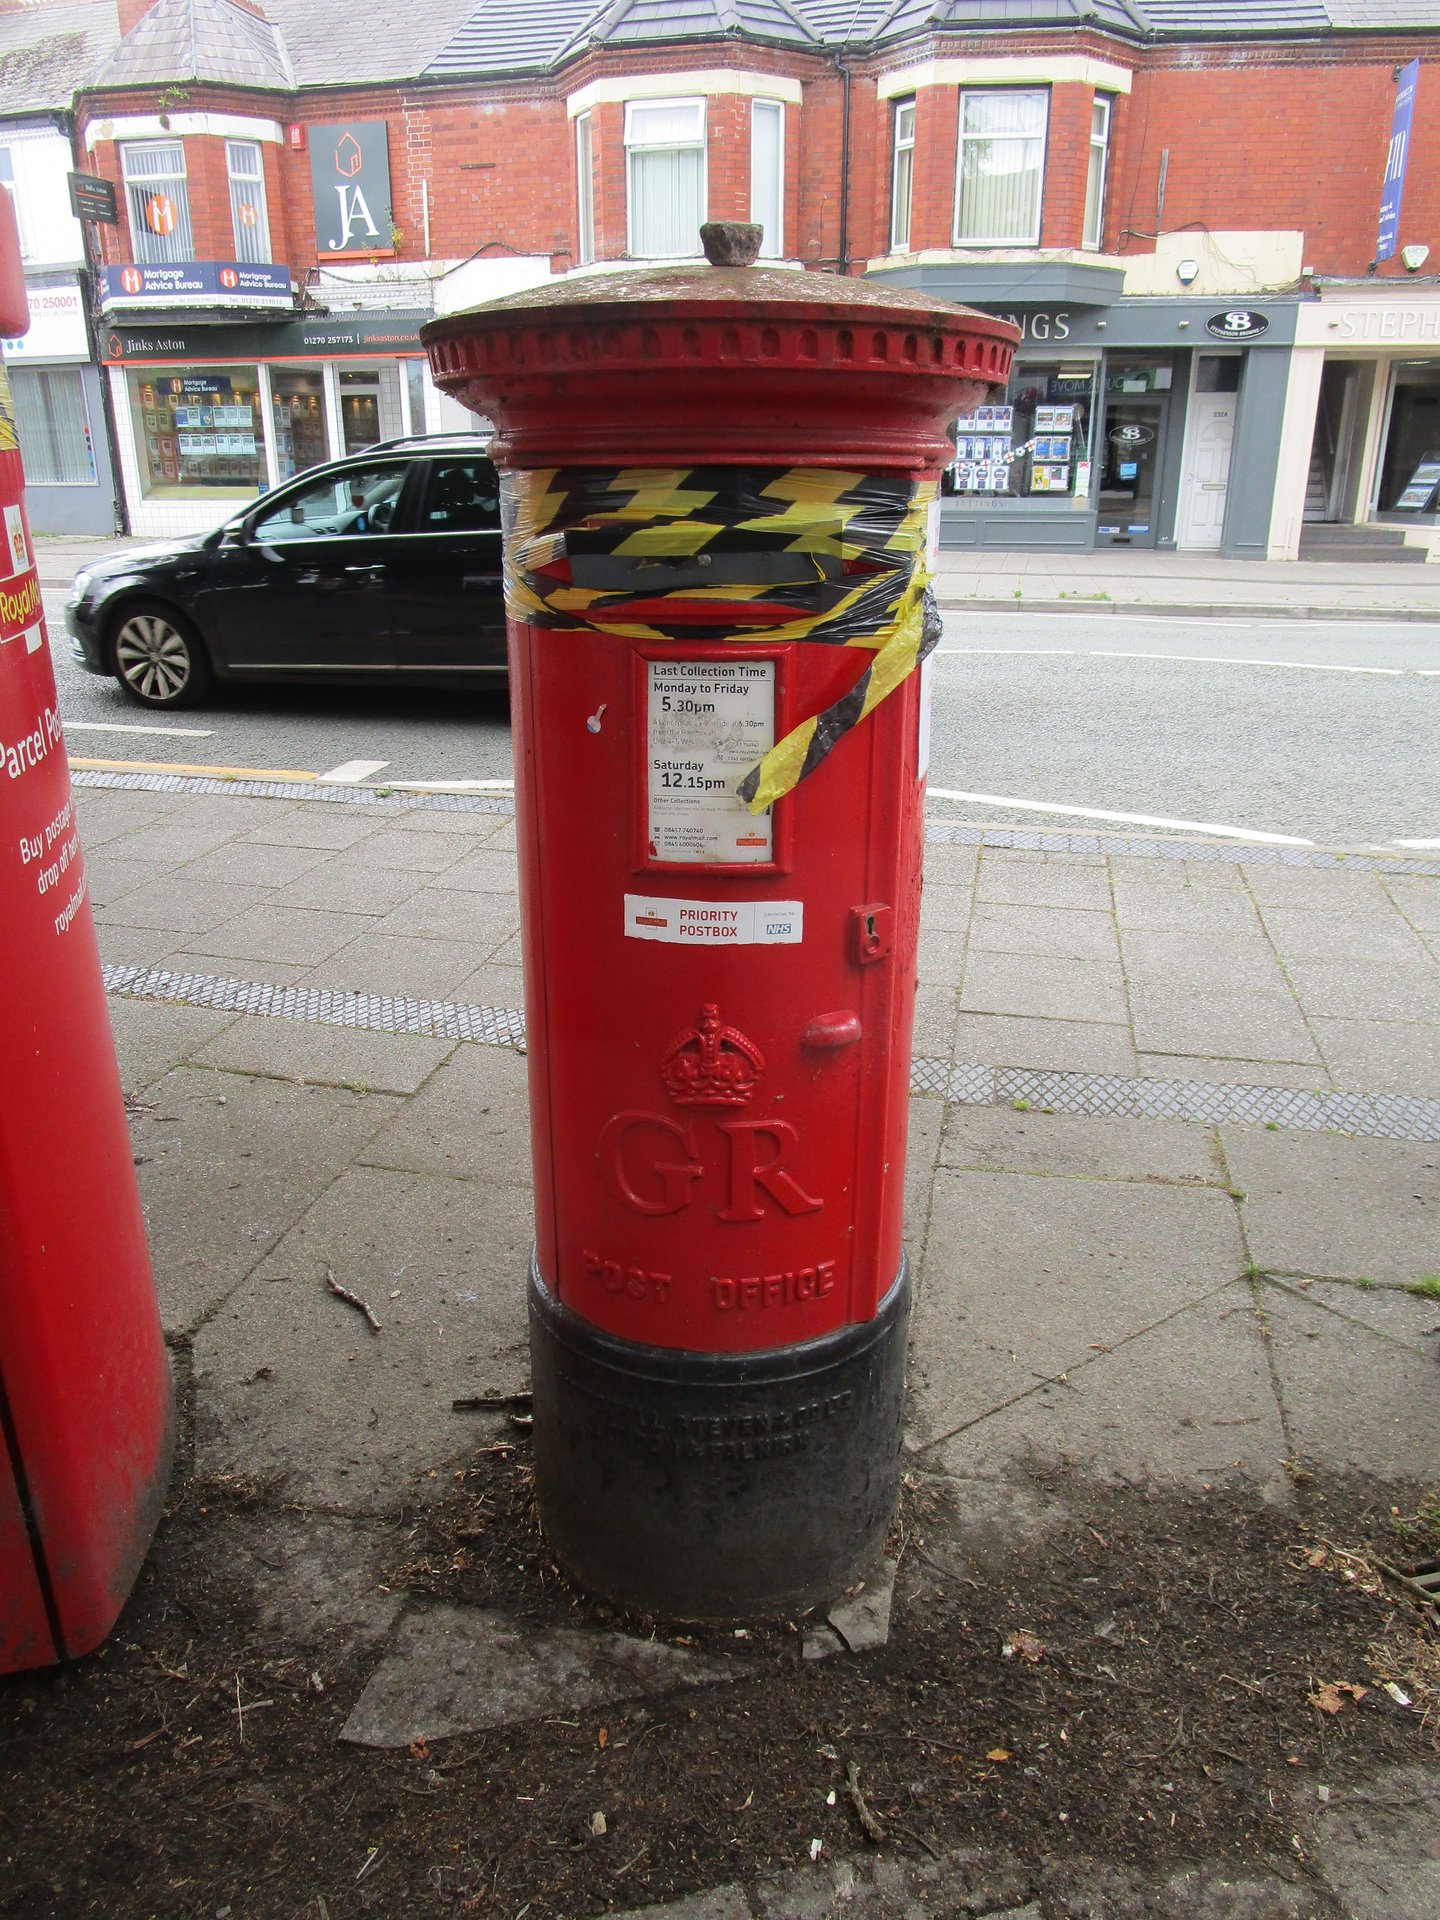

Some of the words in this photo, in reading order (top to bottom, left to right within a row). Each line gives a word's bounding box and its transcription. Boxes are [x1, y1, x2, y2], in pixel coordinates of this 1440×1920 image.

[328, 184, 381, 250] JA
[143, 269, 185, 281] Mortgage
[239, 271, 272, 281] Mortgage
[145, 280, 173, 290] Advice
[175, 280, 204, 290] Bureau
[239, 280, 263, 288] Advice
[264, 281, 287, 289] Bureau
[43, 296, 78, 309] 250001
[996, 313, 1070, 340] NGS
[1339, 311, 1440, 338] STEPH
[303, 336, 326, 345] 01270
[327, 335, 354, 344] 257173
[363, 333, 420, 344] jinksaston.co.uk
[126, 339, 154, 354] Jinks
[156, 339, 186, 351] Aston
[0, 581, 32, 626] Royal
[653, 665, 678, 676] Last
[680, 665, 735, 677] Collection
[738, 666, 767, 677] Time
[653, 682, 697, 695] Monday
[700, 684, 711, 694] to
[714, 683, 750, 696] Friday
[661, 696, 716, 714] 5.30pm
[653, 759, 704, 772] Saturday
[661, 772, 726, 791] 12.15pm
[19, 832, 43, 865] Buy
[45, 801, 71, 851] postage
[37, 862, 59, 895] drop
[60, 842, 70, 874] off
[679, 909, 738, 922] PRIORITY
[679, 925, 738, 937] POSTBOX
[767, 924, 791, 934] NHS
[581, 1247, 672, 1305] POST
[710, 1257, 836, 1311] OFFICE
